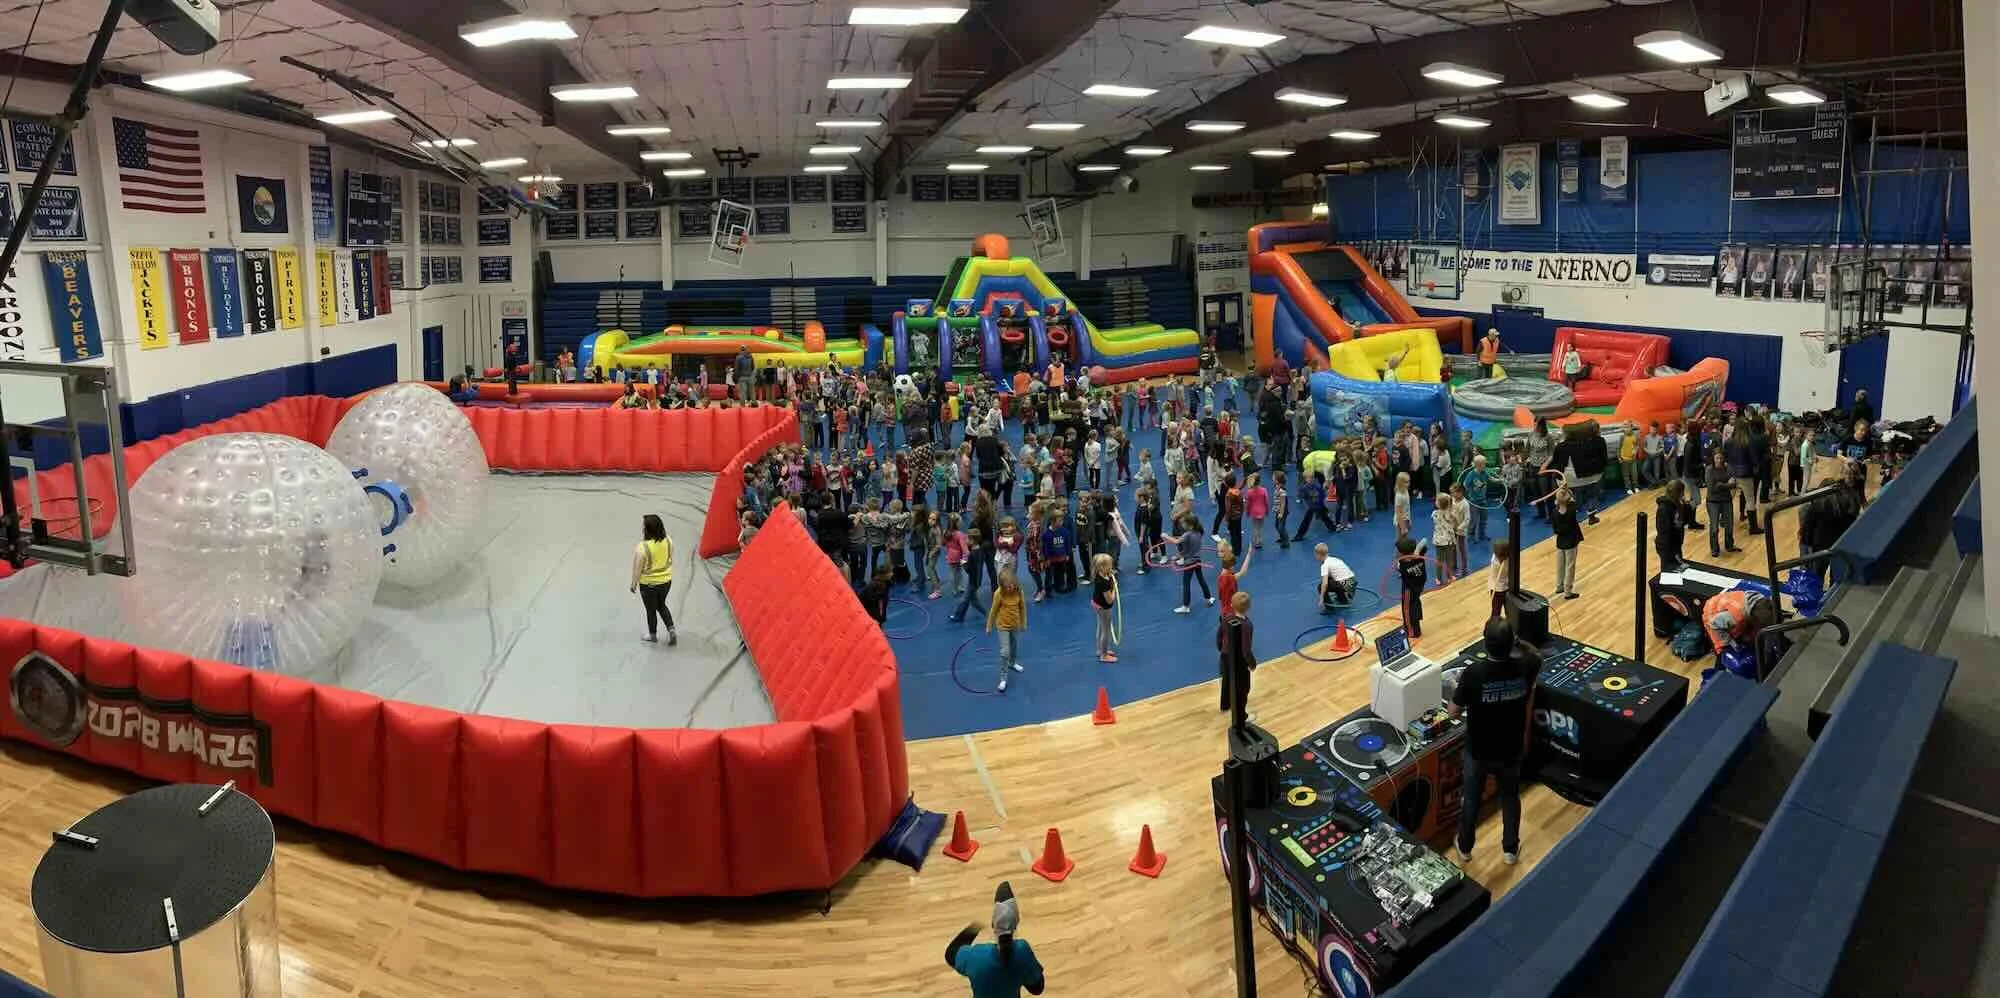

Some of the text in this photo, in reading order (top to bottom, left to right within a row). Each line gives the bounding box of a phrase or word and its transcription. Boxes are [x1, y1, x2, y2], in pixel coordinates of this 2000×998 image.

[1811, 128, 1839, 140] GUEST
[182, 264, 199, 333] BRONCS
[253, 260, 268, 331] BRONCS
[284, 260, 297, 326] PIRATES
[1495, 260, 1509, 271] TO
[1511, 258, 1534, 272] THE
[1537, 257, 1632, 282] INFERNO
[62, 264, 89, 360] BEAVERS
[140, 269, 157, 341] JACKETS
[167, 720, 256, 769] WARS
[1534, 708, 1574, 738] OP!
